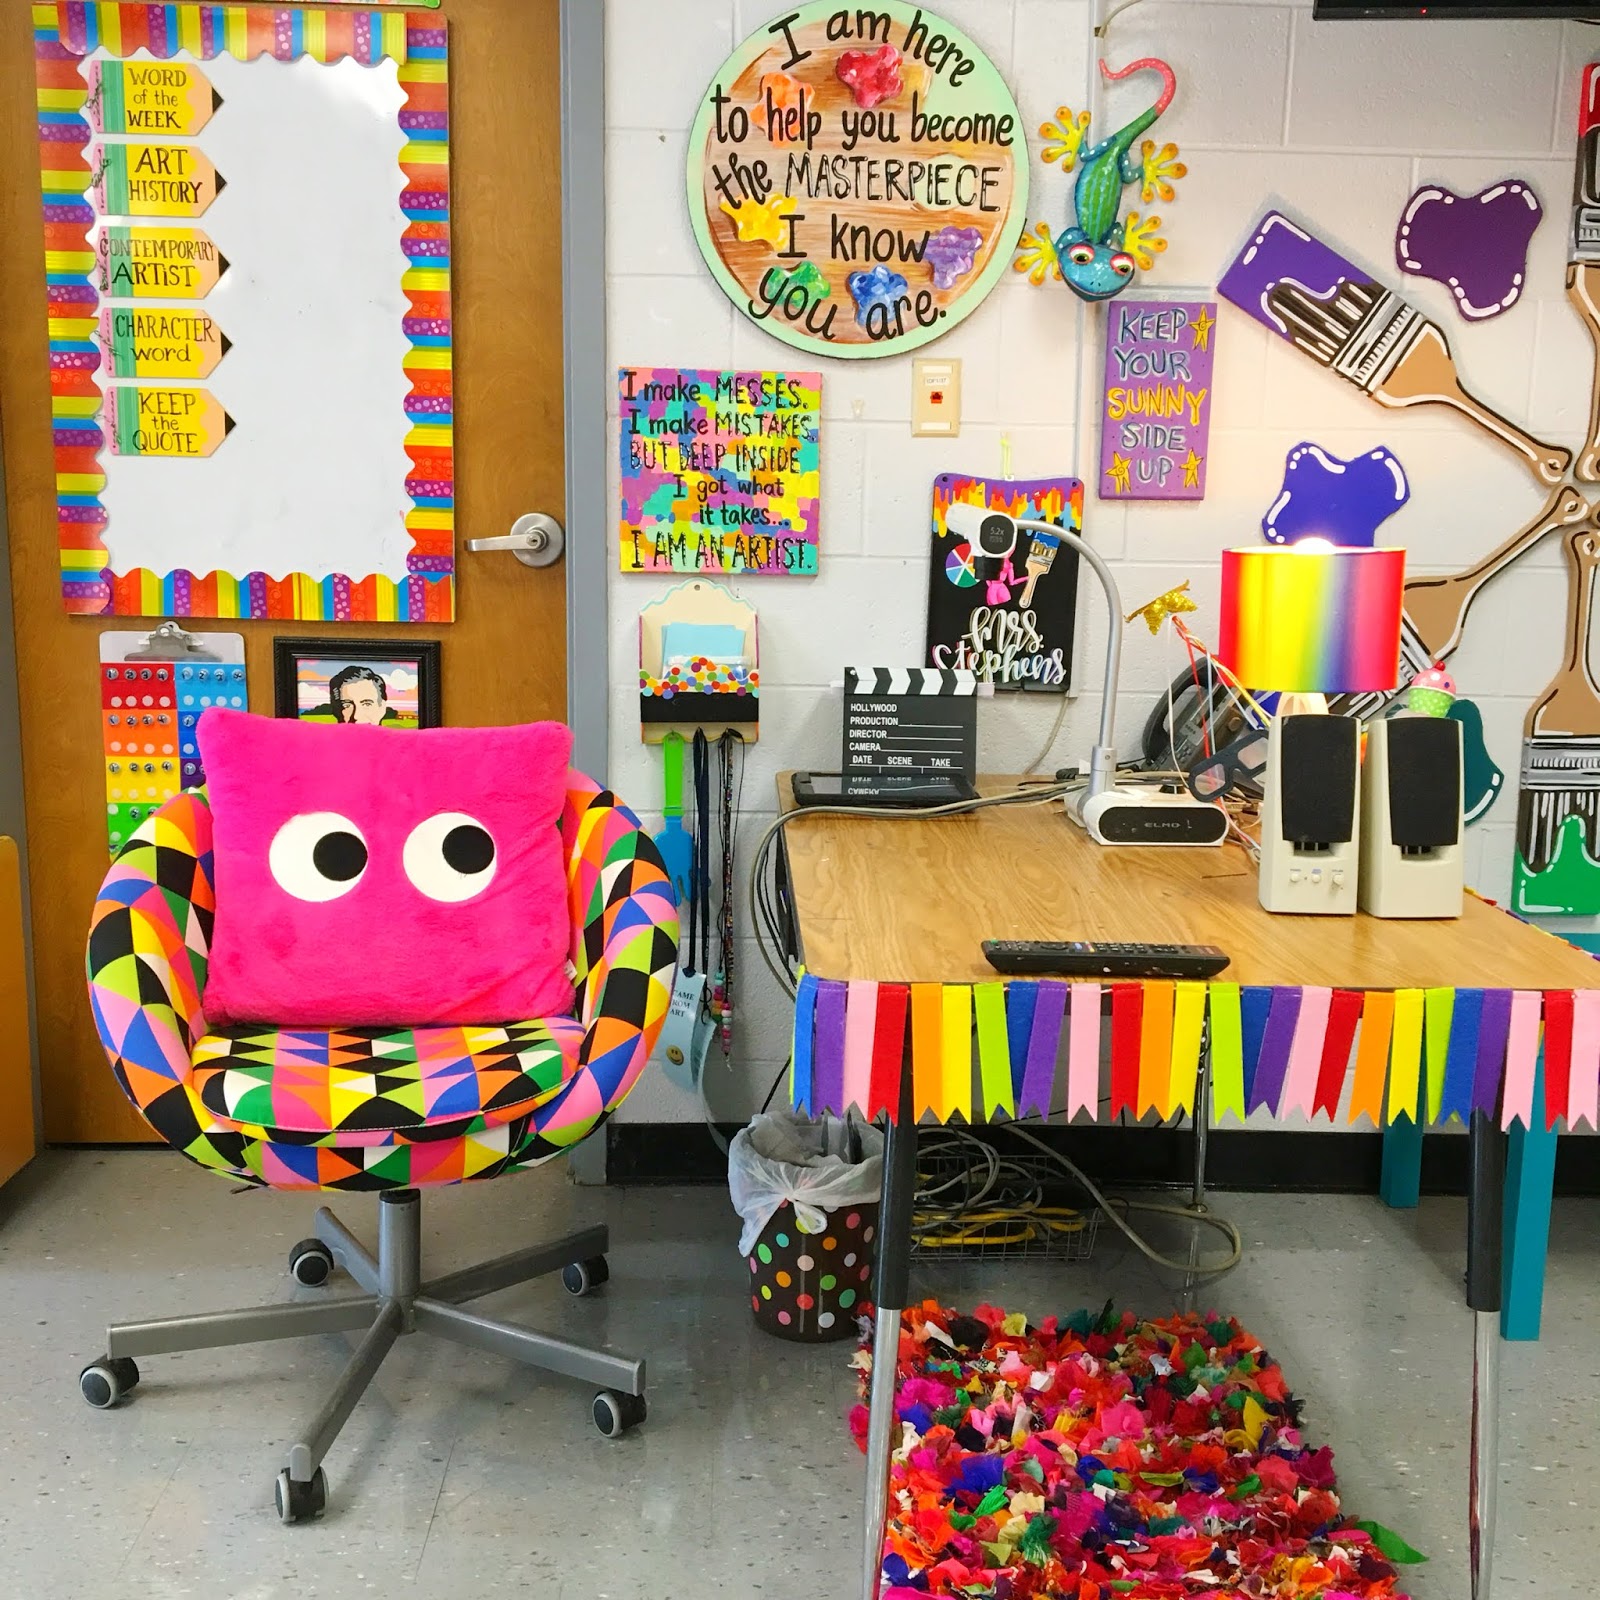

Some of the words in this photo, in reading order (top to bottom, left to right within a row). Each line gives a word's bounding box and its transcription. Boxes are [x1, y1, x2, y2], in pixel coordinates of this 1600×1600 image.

[768, 13, 812, 70] I
[827, 9, 891, 43] am
[903, 9, 975, 87] here
[128, 68, 187, 87] WORD
[133, 89, 148, 104] of
[154, 90, 179, 106] the
[126, 110, 181, 129] WEEK
[710, 84, 749, 143] to
[766, 86, 822, 150] help
[842, 110, 901, 151] you
[911, 90, 1015, 146] become
[134, 148, 188, 175] ART
[129, 180, 203, 204] HISTORY
[712, 152, 772, 210] the
[785, 152, 1003, 212] MASTERPIECE
[99, 238, 214, 261] CONTEMPORARY
[777, 214, 807, 258] I
[831, 213, 931, 263] know
[748, 268, 838, 341] you
[865, 290, 947, 341] are.
[115, 314, 215, 342] CHARACTER
[1118, 306, 1188, 344] KEEP
[130, 344, 191, 362] word
[1112, 346, 1192, 382] YOUR
[624, 371, 637, 401] I
[644, 375, 700, 402] make
[715, 376, 808, 410] MESSES.
[138, 392, 196, 416] KEEP
[1107, 383, 1207, 426] SUNNY
[151, 416, 180, 431] the
[628, 409, 641, 435] I
[649, 411, 708, 435] make
[132, 430, 199, 453] QUOTE
[1120, 421, 1186, 452] SIDE
[630, 441, 672, 470] BUT
[679, 442, 727, 471] DEEP
[736, 444, 800, 474] INSIDE
[1136, 455, 1175, 488] UP
[673, 474, 686, 498] I
[697, 475, 727, 502] got
[738, 475, 784, 497] what
[699, 503, 714, 525] it
[631, 530, 645, 568] I
[653, 531, 687, 567] AM
[695, 533, 724, 568] AN
[732, 533, 814, 569] ARTIST.
[932, 640, 1066, 684] Stephens
[850, 703, 898, 713] HOLLYWOOD
[850, 716, 899, 726] PRODUCTION
[849, 729, 887, 739] DIRECTOR
[849, 742, 881, 751] CAMERA
[852, 755, 873, 764] DATE
[887, 756, 913, 766] SCENE
[930, 758, 951, 767] TAKE
[671, 999, 691, 1009] ROM
[674, 990, 695, 1001] AME
